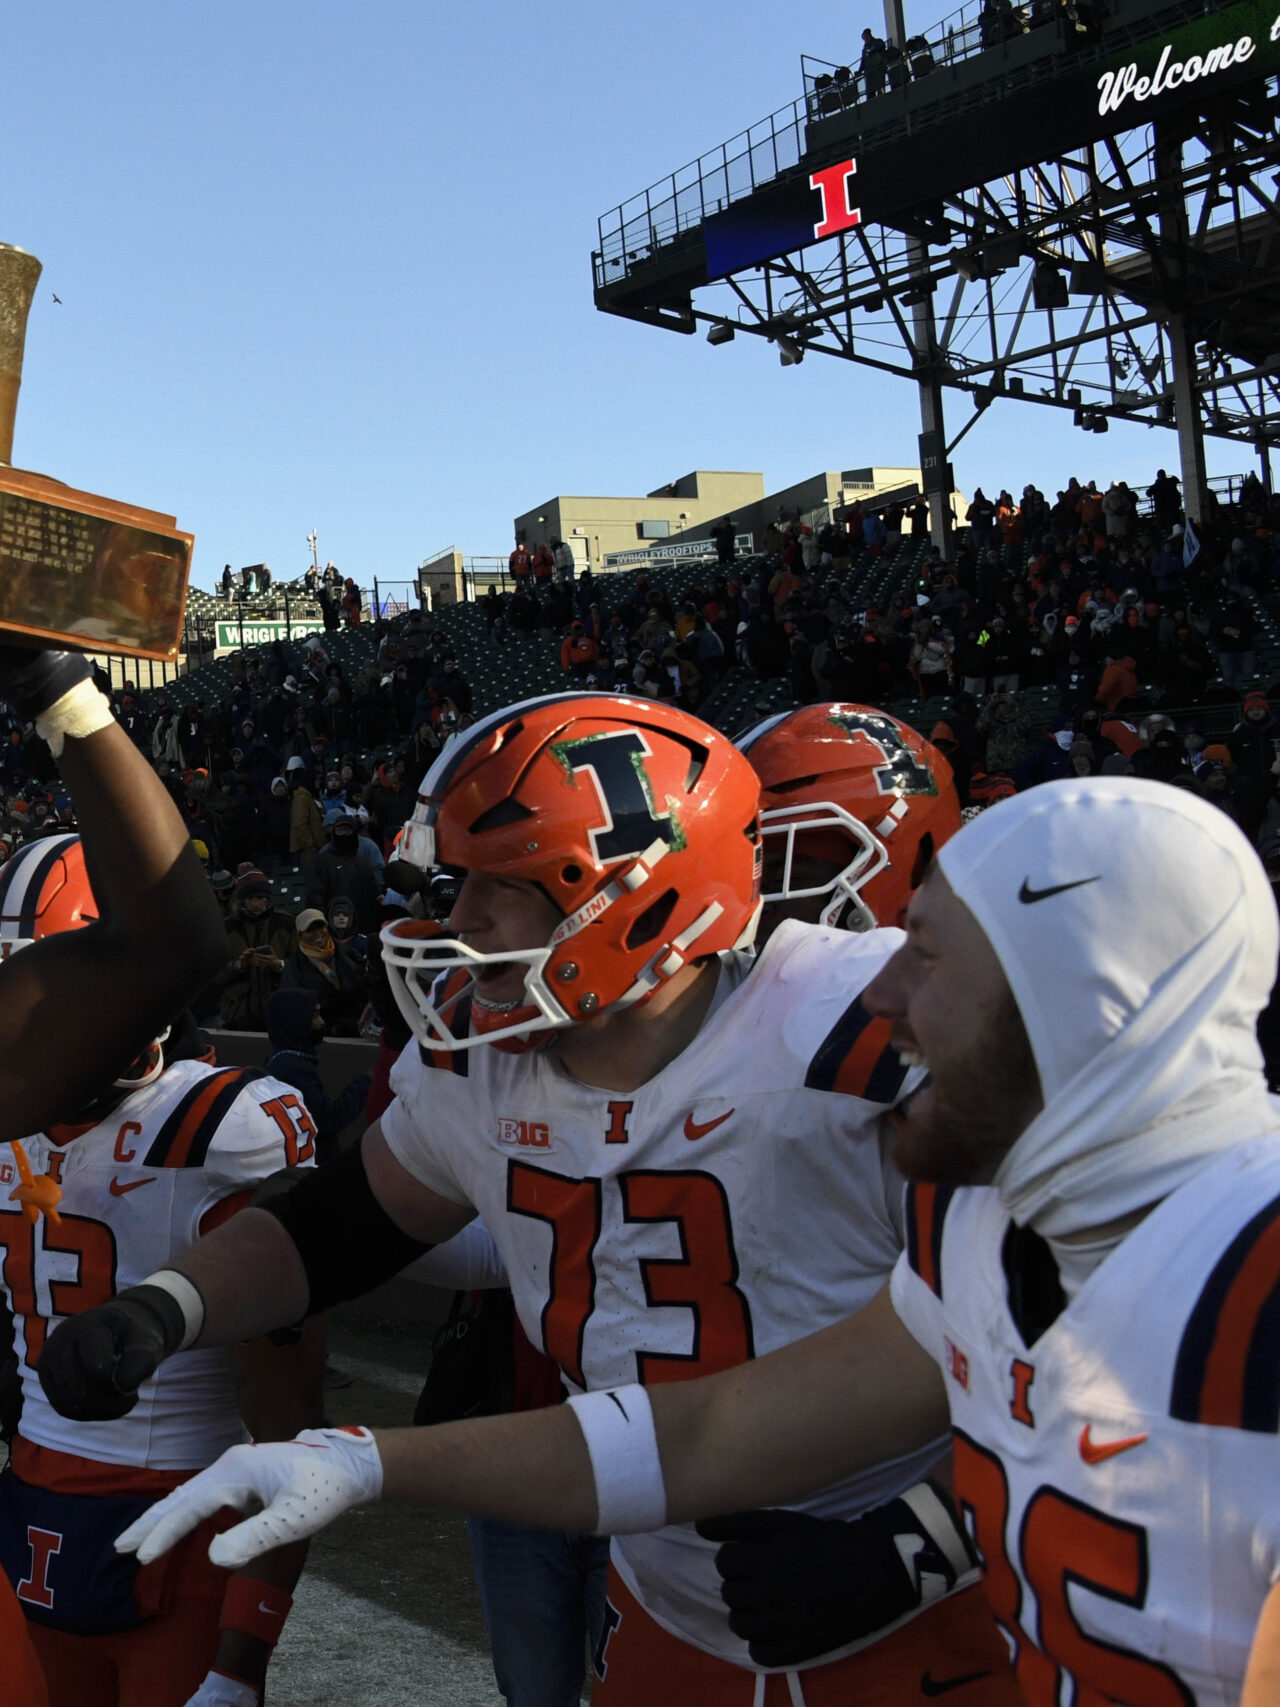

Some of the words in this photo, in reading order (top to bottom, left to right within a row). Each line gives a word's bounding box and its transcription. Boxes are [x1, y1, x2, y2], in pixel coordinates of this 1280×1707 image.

[1097, 36, 1257, 116] Welcome
[923, 456, 937, 469] 231
[112, 1121, 142, 1163] C
[259, 1094, 317, 1167] 13
[507, 1159, 757, 1393] 73
